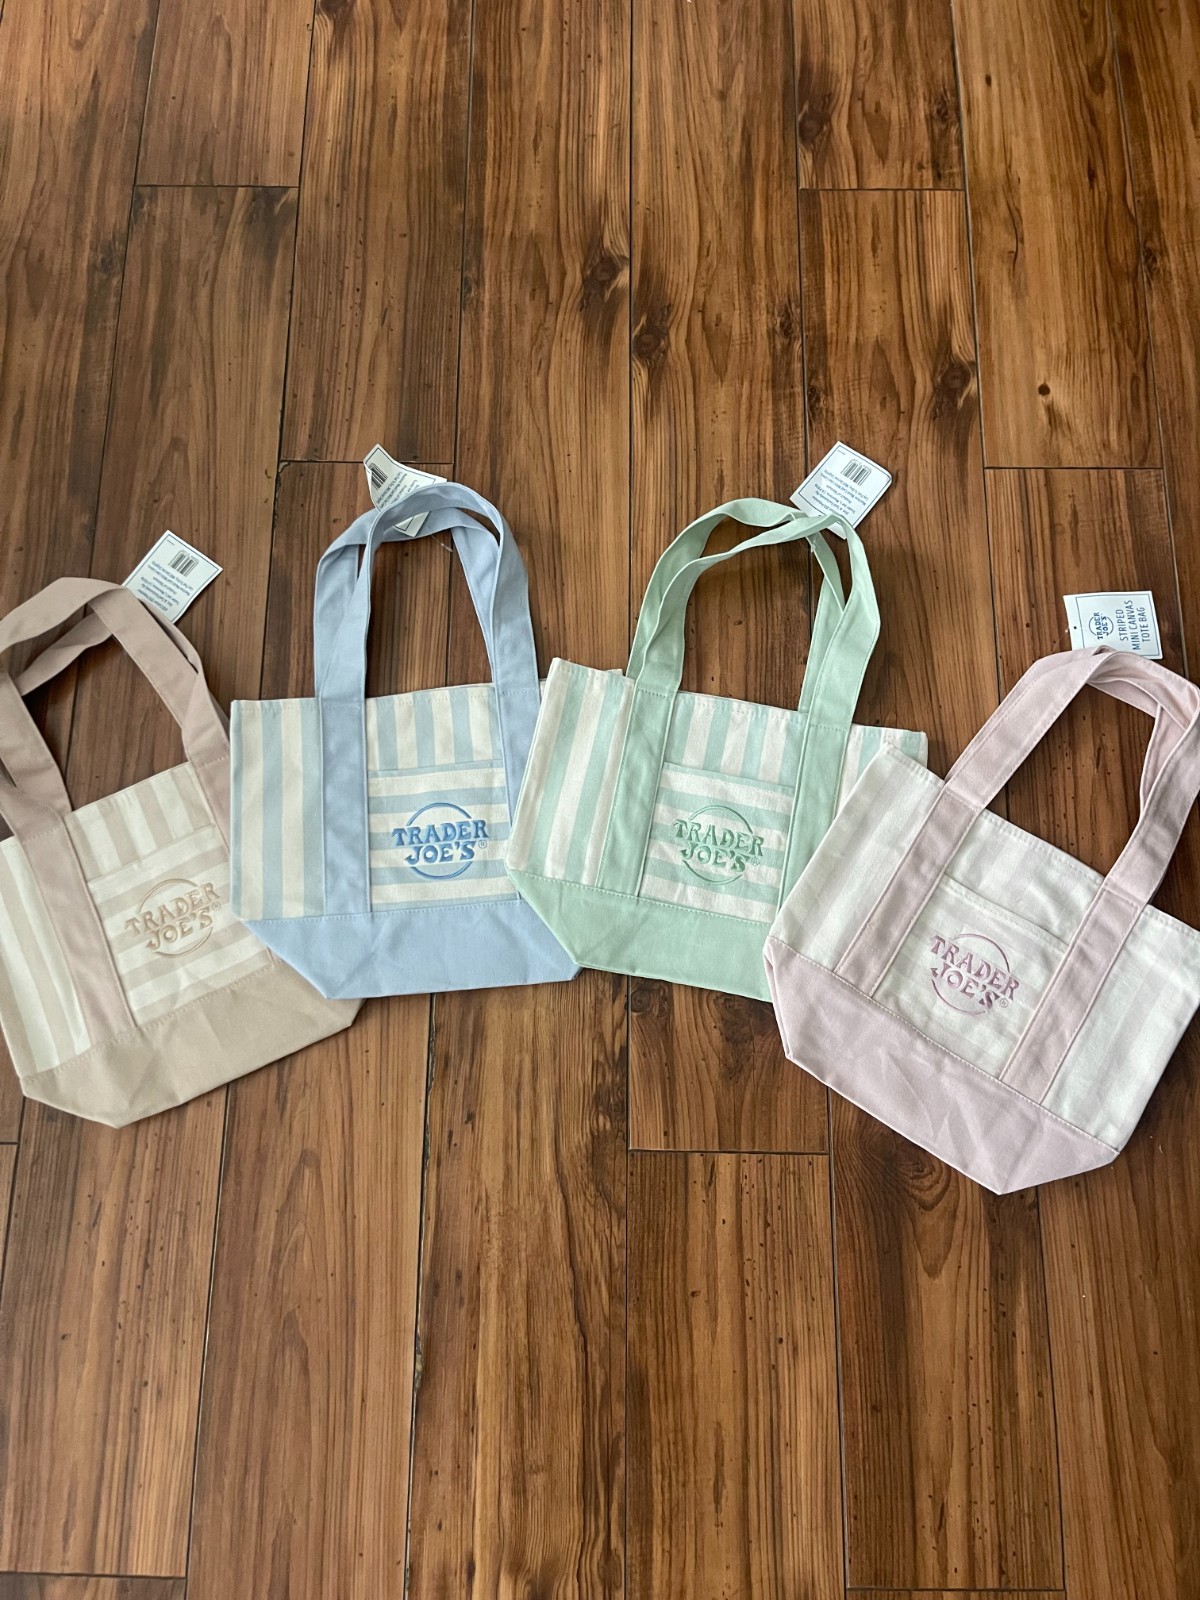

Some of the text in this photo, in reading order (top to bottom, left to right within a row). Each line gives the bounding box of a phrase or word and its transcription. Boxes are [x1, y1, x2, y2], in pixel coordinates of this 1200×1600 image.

[1093, 612, 1103, 640] TRADER
[1115, 609, 1129, 641] STRIPED
[1124, 600, 1141, 650] MINI CANVAS
[1136, 607, 1151, 642] TOTE BAG
[392, 820, 489, 847] TRADER
[673, 819, 764, 857] TRADER
[404, 841, 476, 865] JOE'S
[680, 841, 751, 872] JOE'S
[125, 882, 220, 935] TRADER
[145, 906, 213, 950] JOE'S
[930, 935, 1020, 1001] TRADER
[930, 962, 1000, 1009] JOE'S
